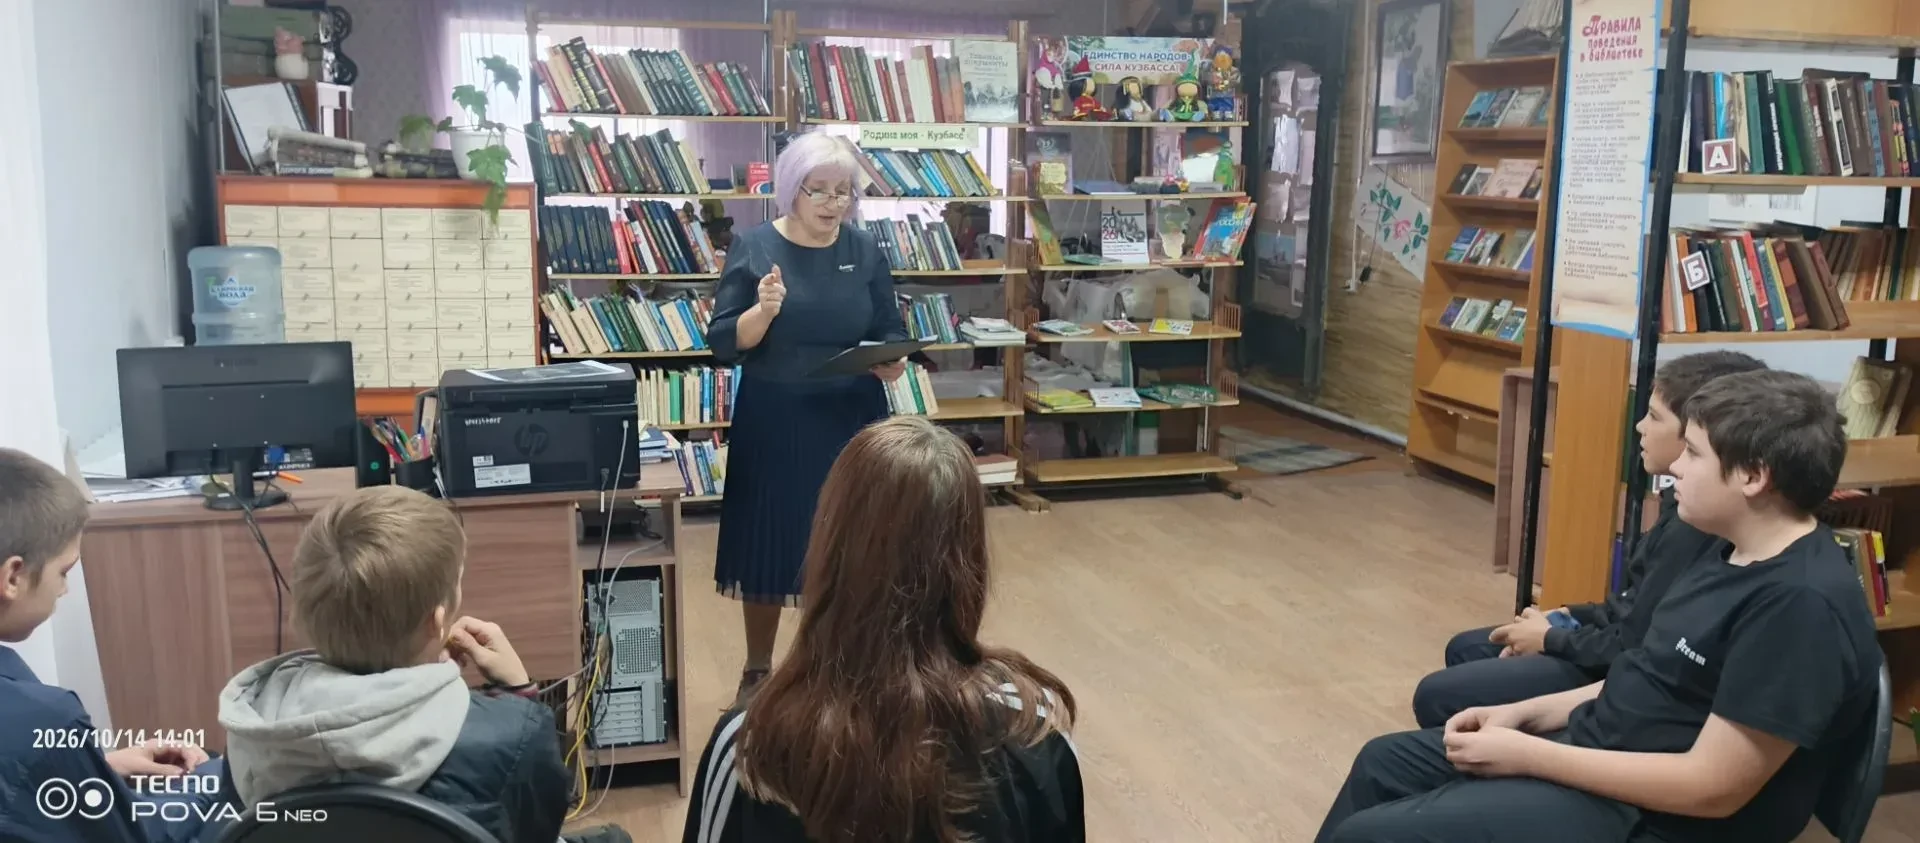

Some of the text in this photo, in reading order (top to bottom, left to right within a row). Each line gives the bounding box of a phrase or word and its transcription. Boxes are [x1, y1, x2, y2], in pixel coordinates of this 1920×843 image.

[1084, 52, 1137, 60] ЕДИНСТВО
[1139, 53, 1187, 61] НАРОДОВ
[1094, 63, 1122, 71] СИЛА
[863, 130, 898, 140] Родина
[927, 130, 964, 141] Кузбасс
[1709, 146, 1729, 168] А
[1687, 260, 1704, 282] Б
